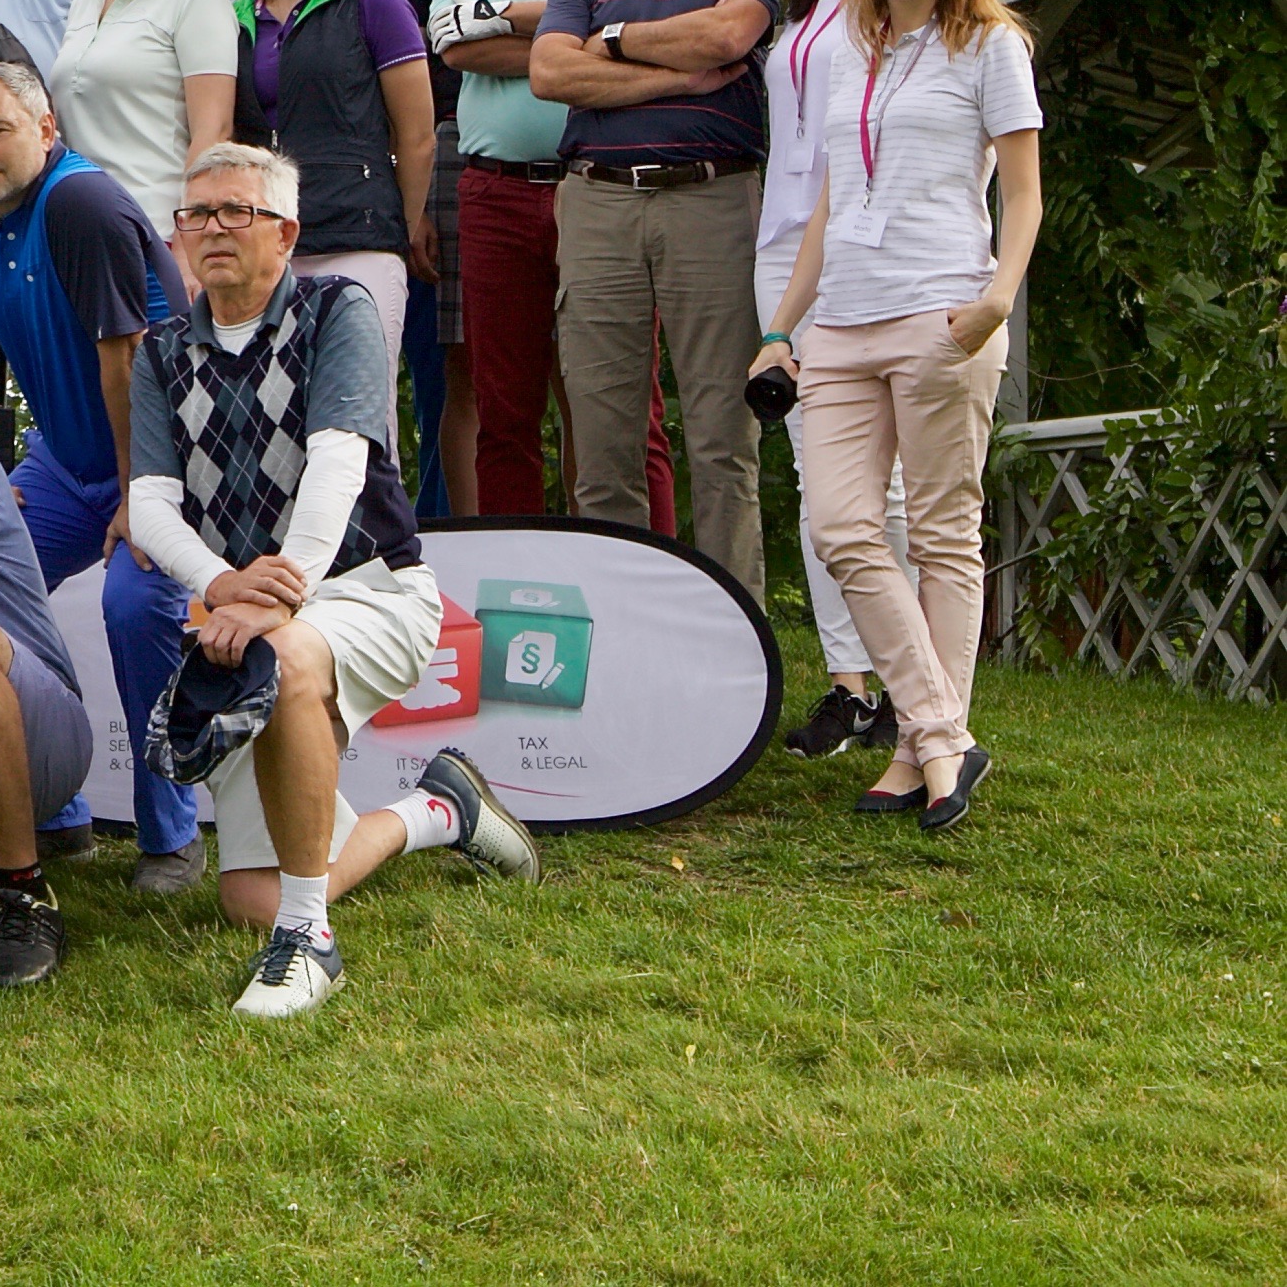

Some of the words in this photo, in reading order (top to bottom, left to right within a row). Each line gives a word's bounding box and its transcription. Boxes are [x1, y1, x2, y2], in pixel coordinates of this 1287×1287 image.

[518, 736, 548, 750] TAX
[397, 758, 407, 771] IT
[521, 756, 533, 770] &
[537, 756, 588, 770] LEGAL
[399, 777, 411, 790] &
